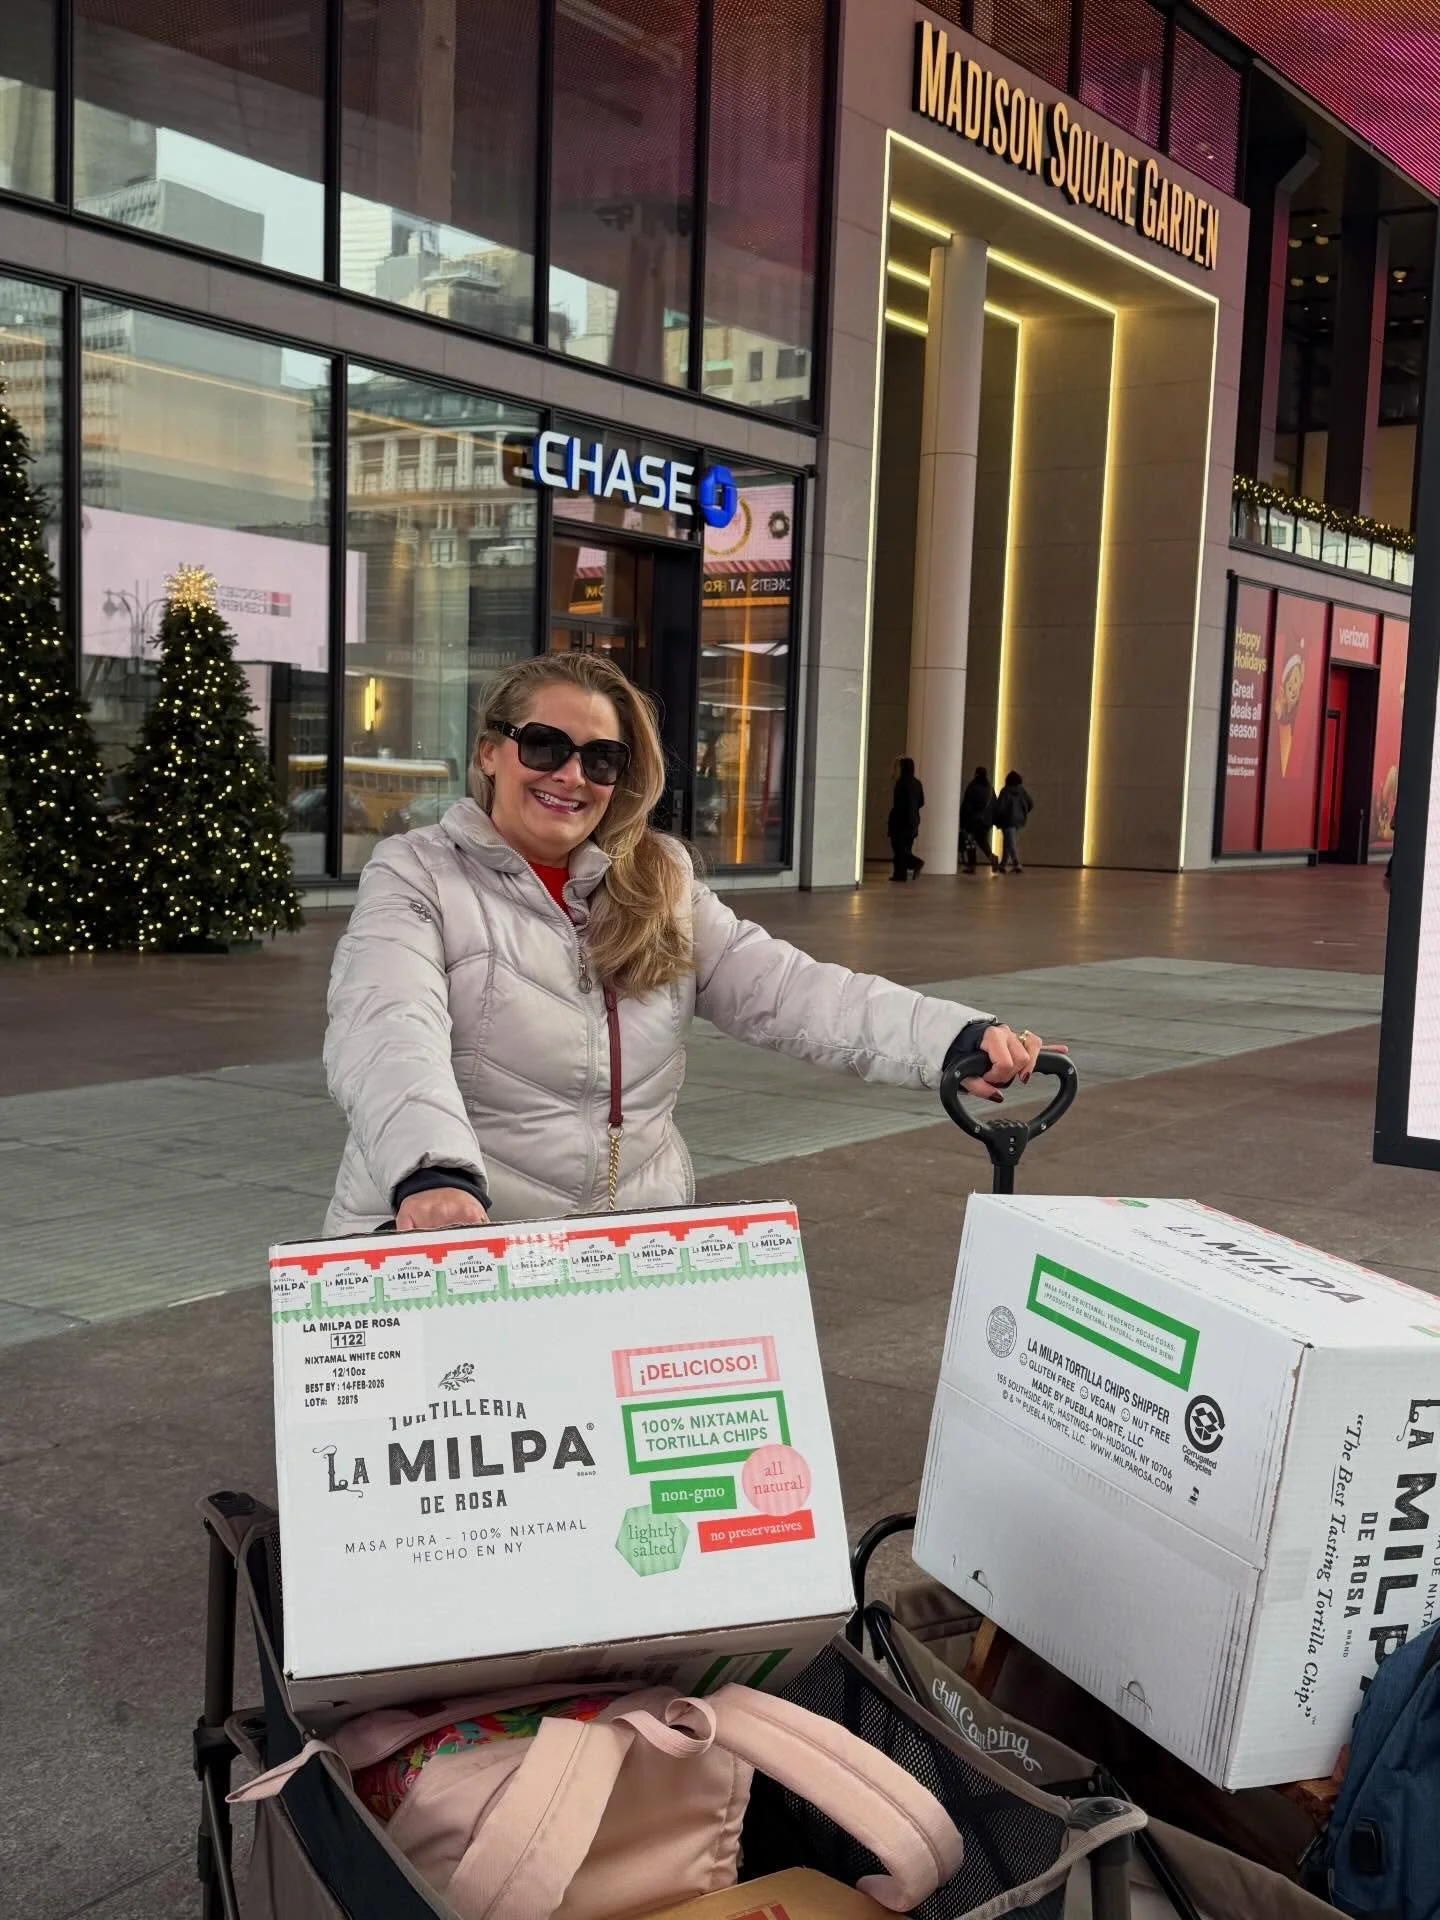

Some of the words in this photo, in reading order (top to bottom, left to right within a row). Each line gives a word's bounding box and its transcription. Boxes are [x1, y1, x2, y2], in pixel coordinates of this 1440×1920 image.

[917, 20, 1044, 176] MADISON
[1050, 102, 1138, 227] SQUARE
[1142, 159, 1219, 270] GARDEN
[535, 431, 695, 515] CHASE
[1235, 627, 1261, 650] Happy
[1338, 625, 1369, 650] verizon
[1233, 650, 1267, 674] Holidays
[1231, 679, 1254, 699] Great
[1230, 701, 1251, 720] deals
[1252, 703, 1261, 720] all
[1229, 724, 1257, 739] season
[642, 1248, 674, 1258] MILPA
[701, 1243, 734, 1253] MILPA
[760, 1238, 793, 1247] MILPA
[459, 1265, 493, 1275] MILPA
[581, 1254, 614, 1264] MILPA
[335, 1276, 369, 1286] MILPA
[397, 1270, 432, 1281] MILPA
[1204, 1242, 1365, 1303] MILPA
[273, 1282, 306, 1292] MILPA
[303, 1324, 316, 1333] LA
[320, 1321, 352, 1332] MILPA
[355, 1320, 369, 1329] DE
[371, 1318, 400, 1328] ROSA
[334, 1334, 363, 1346] 1122
[304, 1355, 347, 1365] NIXTAMAL
[349, 1352, 376, 1361] WHITE
[378, 1350, 401, 1359] CORN
[333, 1367, 366, 1377] 12/10oz
[640, 1354, 758, 1386] ¡DELICIOSO!
[1028, 1337, 1037, 1354] LA
[1039, 1344, 1063, 1368] MILPA
[1065, 1357, 1102, 1389] TORTILLA
[1104, 1379, 1131, 1403] CHIPS
[1131, 1392, 1170, 1424] SHIPPER
[305, 1383, 324, 1393] BEST
[326, 1382, 336, 1392] BY
[304, 1398, 328, 1407] LOT#:
[1028, 1360, 1056, 1382] GLUTEN
[1057, 1374, 1076, 1392] FREE
[1090, 1393, 1116, 1414] VEGAN
[1132, 1416, 1149, 1432] NUT
[1150, 1425, 1170, 1444] FREE
[1031, 1378, 1053, 1398] MADE
[1054, 1390, 1064, 1403] BY
[1065, 1396, 1094, 1421] PUEBLA
[1096, 1413, 1125, 1439] NORTE,
[1128, 1432, 1144, 1448] LLC
[641, 1417, 685, 1434] 100%
[690, 1409, 769, 1430] NIXTAMAL
[1008, 1379, 1042, 1405] SOUTHSIDE
[1042, 1400, 1056, 1415] AVE,
[1057, 1408, 1137, 1461] HASTINGS-ON-HUDSON,
[1140, 1453, 1150, 1466] NY
[1151, 1460, 1173, 1480] 10706
[646, 1431, 719, 1452] TORTILLA
[723, 1427, 768, 1444] CHIPS
[1022, 1401, 1046, 1422] PUEBLA
[1047, 1415, 1070, 1437] NORTE,
[1090, 1440, 1173, 1495] WWW.MILPAROSA.COM
[316, 1446, 369, 1496] LA
[388, 1426, 596, 1486] MILPA
[1182, 1444, 1217, 1469] Corrugated
[1183, 1455, 1212, 1476] Recycles
[764, 1461, 784, 1477] all
[661, 1487, 725, 1503] non-gmo
[753, 1476, 805, 1495] natural
[1335, 1465, 1353, 1507] Best
[420, 1496, 445, 1515] DE
[456, 1489, 508, 1511] ROSA
[345, 1540, 387, 1553] MASA
[396, 1535, 437, 1549] PURA
[461, 1528, 501, 1542] 100%
[510, 1519, 587, 1537] NIXTAMAL
[628, 1521, 677, 1544] lightly
[710, 1530, 725, 1541] no
[728, 1520, 802, 1543] preservatives
[1358, 1512, 1378, 1541] DE
[413, 1548, 468, 1564] HECHO
[477, 1545, 495, 1557] EN
[505, 1542, 524, 1554] NY
[633, 1539, 677, 1558] salted
[1317, 1514, 1346, 1582] Tasting
[1344, 1554, 1371, 1618] ROSA
[1307, 1588, 1333, 1655] Tortilla
[1343, 1630, 1353, 1657] BRAND
